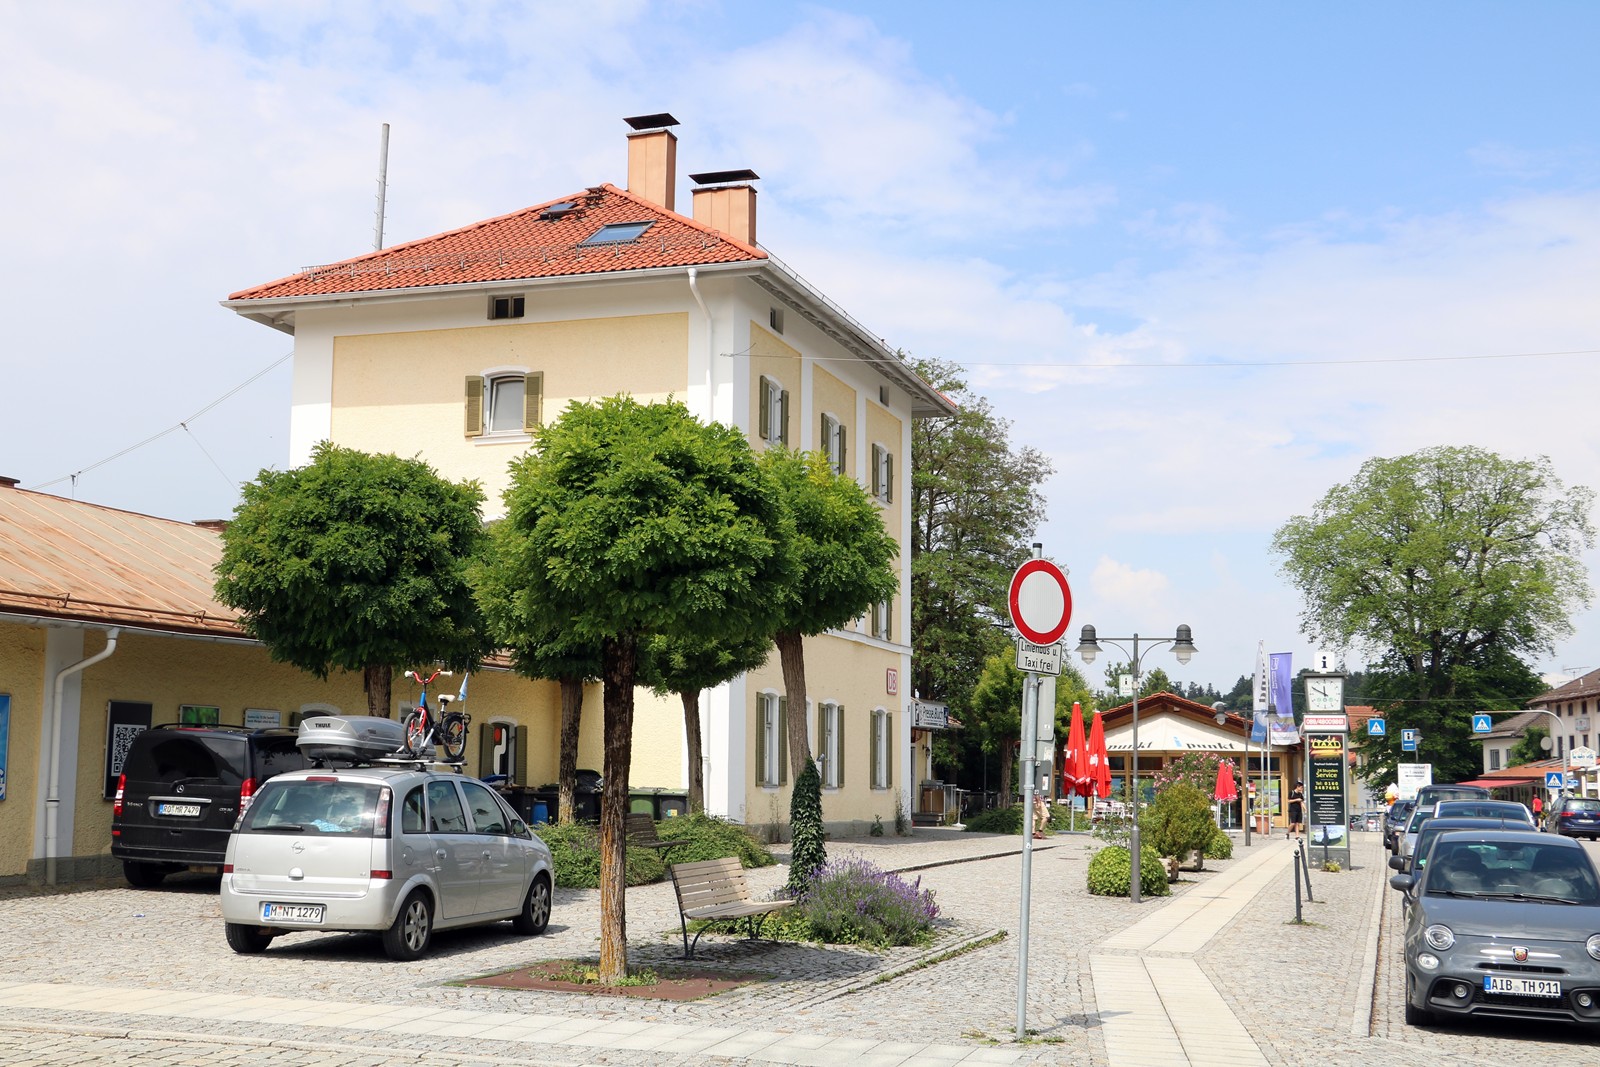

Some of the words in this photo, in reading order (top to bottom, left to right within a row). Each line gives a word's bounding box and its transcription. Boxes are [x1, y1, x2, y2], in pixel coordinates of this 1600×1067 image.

[1025, 656, 1038, 668] Taxi
[1040, 659, 1054, 670] frei
[270, 906, 277, 916] M
[283, 907, 295, 917] NT
[296, 907, 321, 918] 1279
[1492, 979, 1513, 991] AIB
[1521, 981, 1535, 992] TH
[1538, 982, 1559, 994] 911
